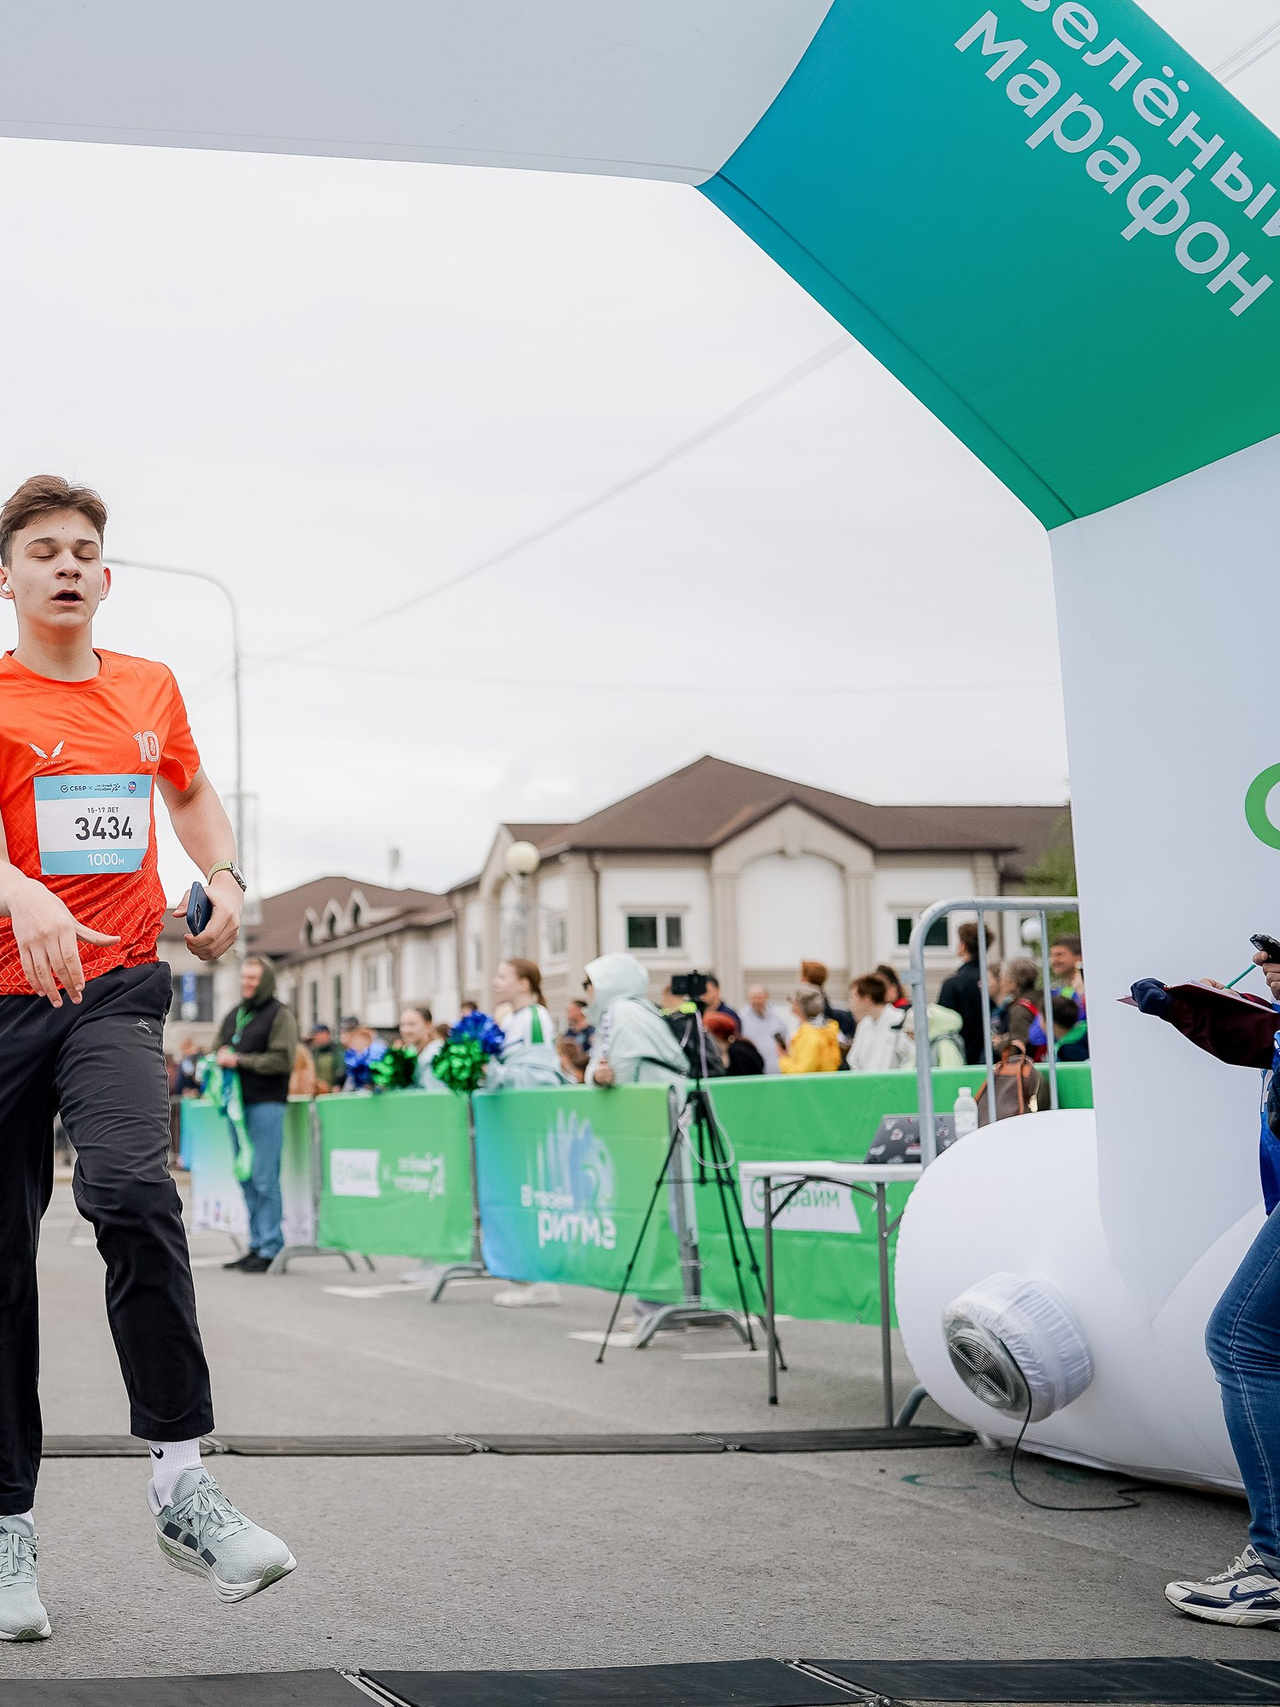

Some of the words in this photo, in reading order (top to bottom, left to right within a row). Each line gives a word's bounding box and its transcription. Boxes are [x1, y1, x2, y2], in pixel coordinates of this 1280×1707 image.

[953, 9, 1274, 318] марафон
[1022, 0, 1280, 237] елёны
[132, 730, 160, 762] 10
[74, 815, 133, 841] 3434
